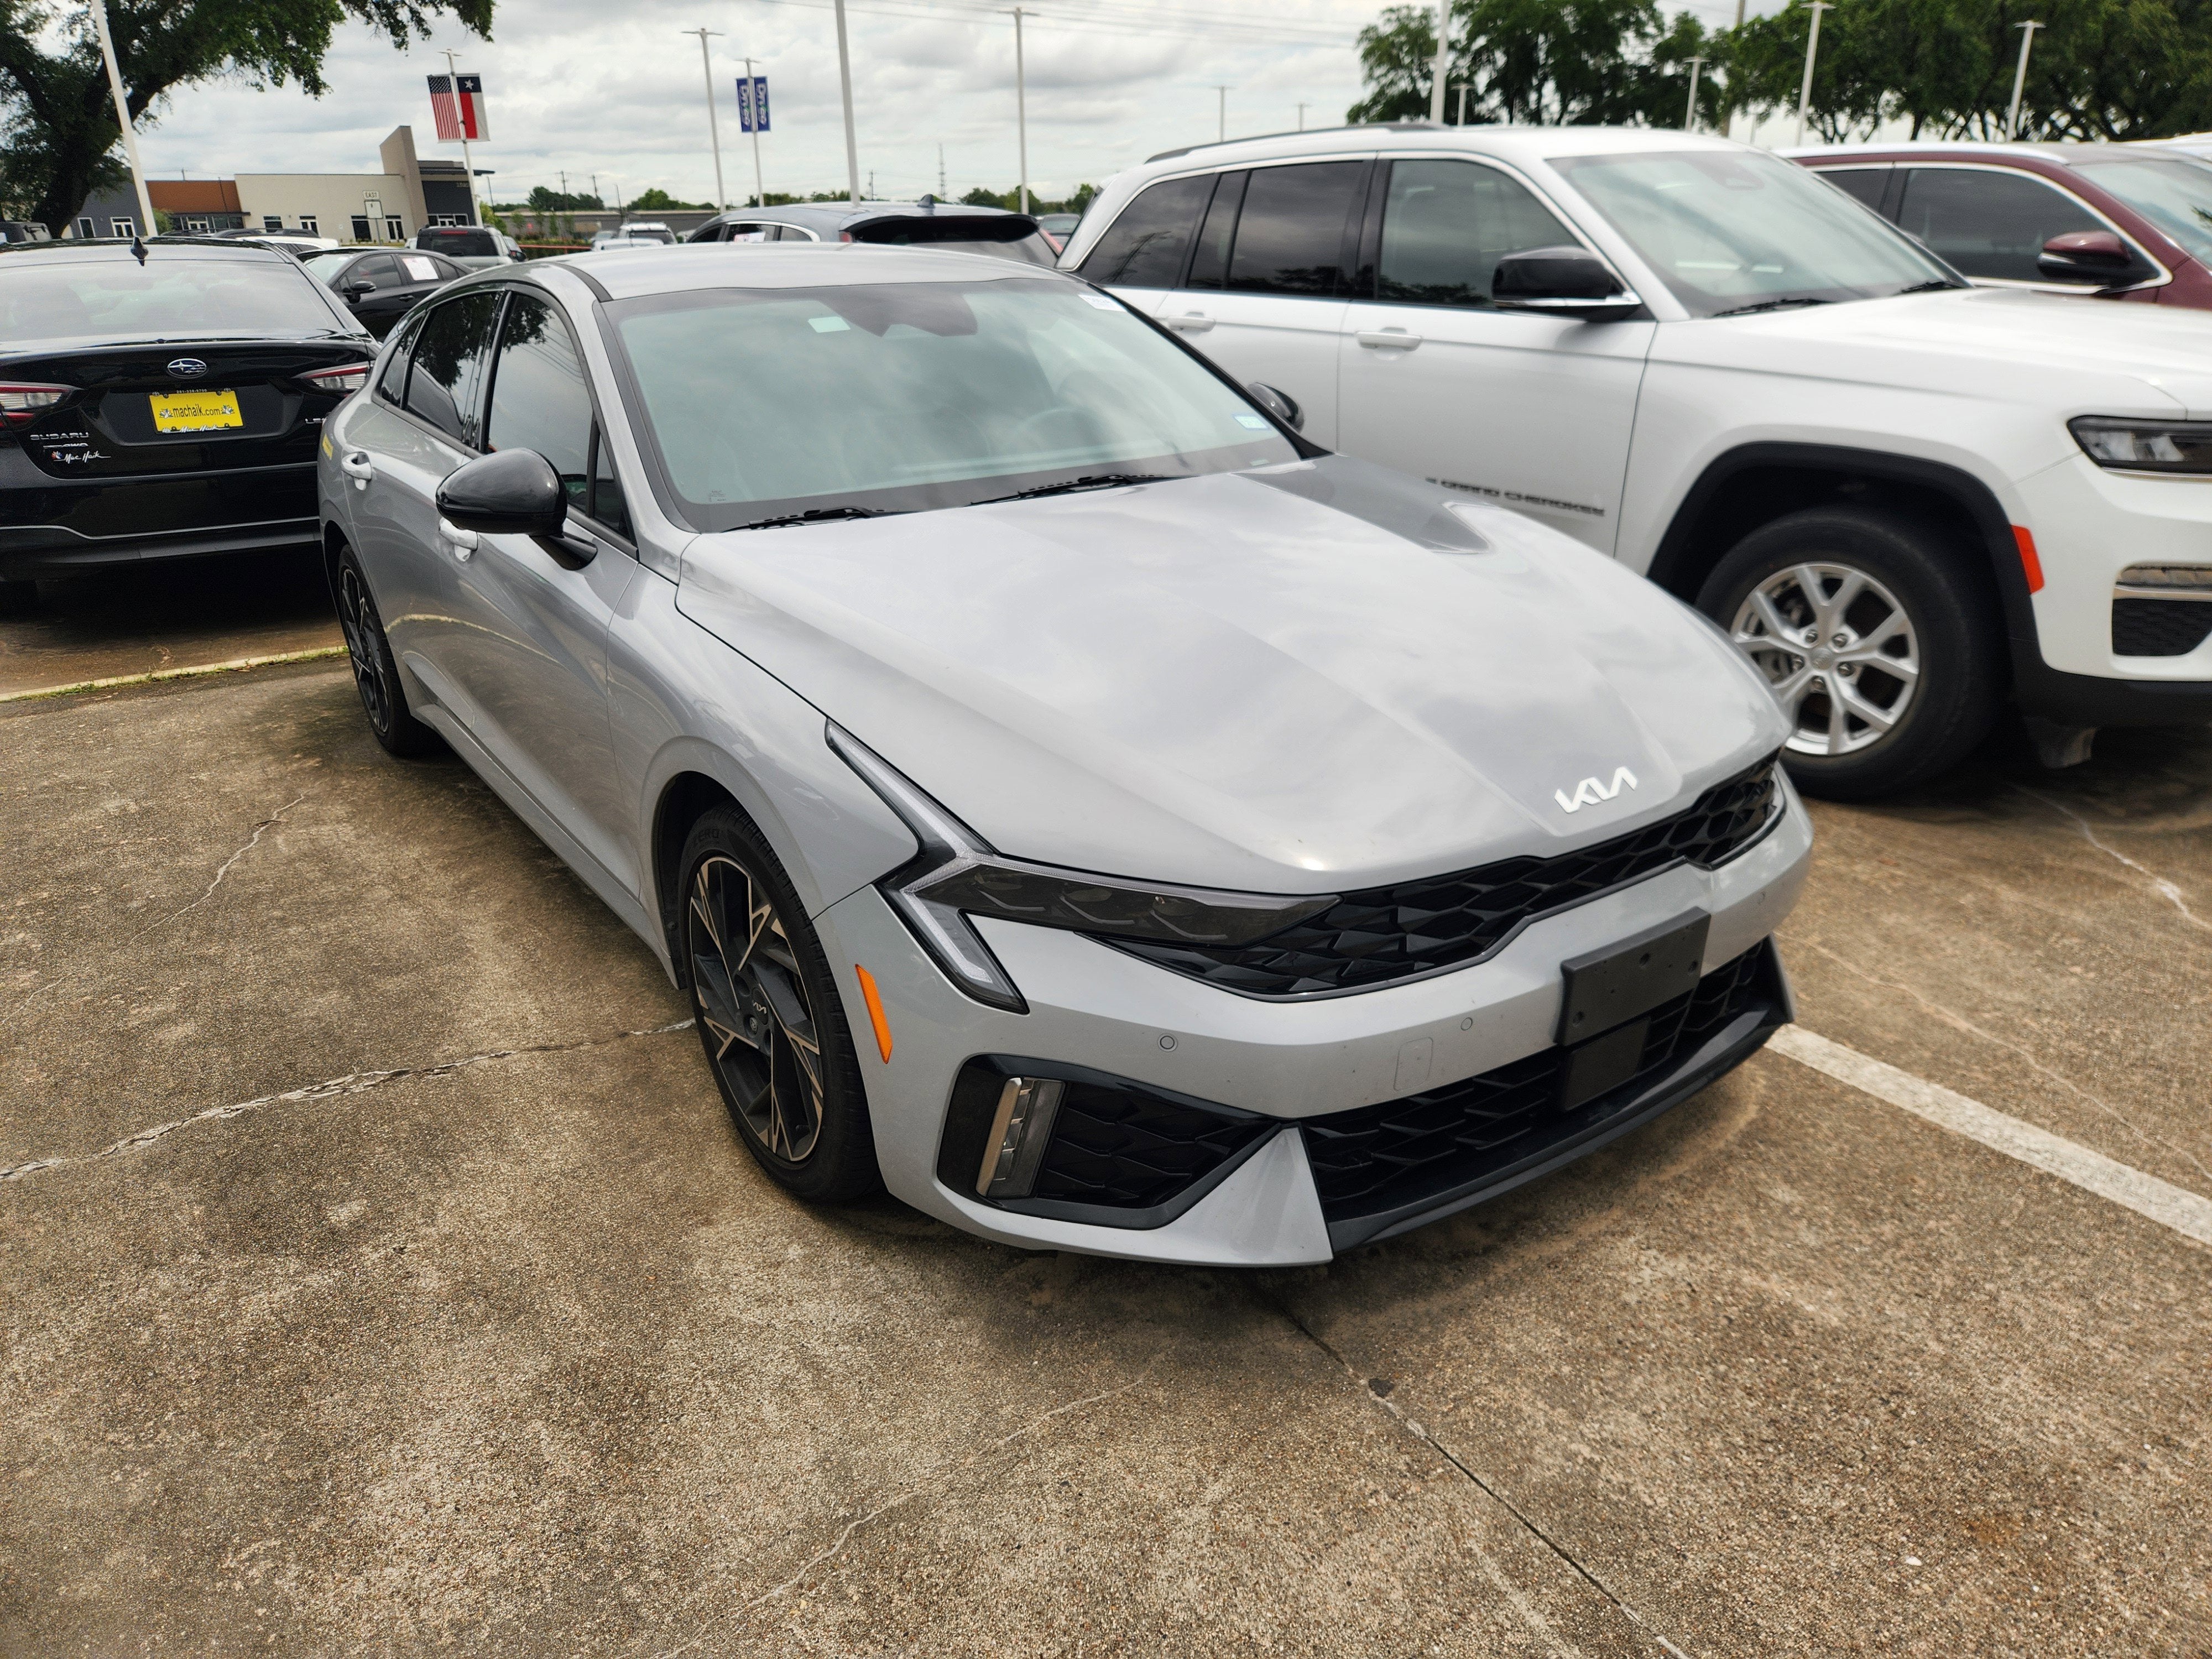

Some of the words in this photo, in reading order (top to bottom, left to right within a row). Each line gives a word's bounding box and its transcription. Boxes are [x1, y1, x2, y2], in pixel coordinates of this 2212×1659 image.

[173, 404, 220, 418] machaik.com
[30, 432, 89, 440] SUBARU
[59, 453, 81, 464] Mac
[82, 450, 106, 463] Haik
[1554, 766, 1638, 814] KIA
